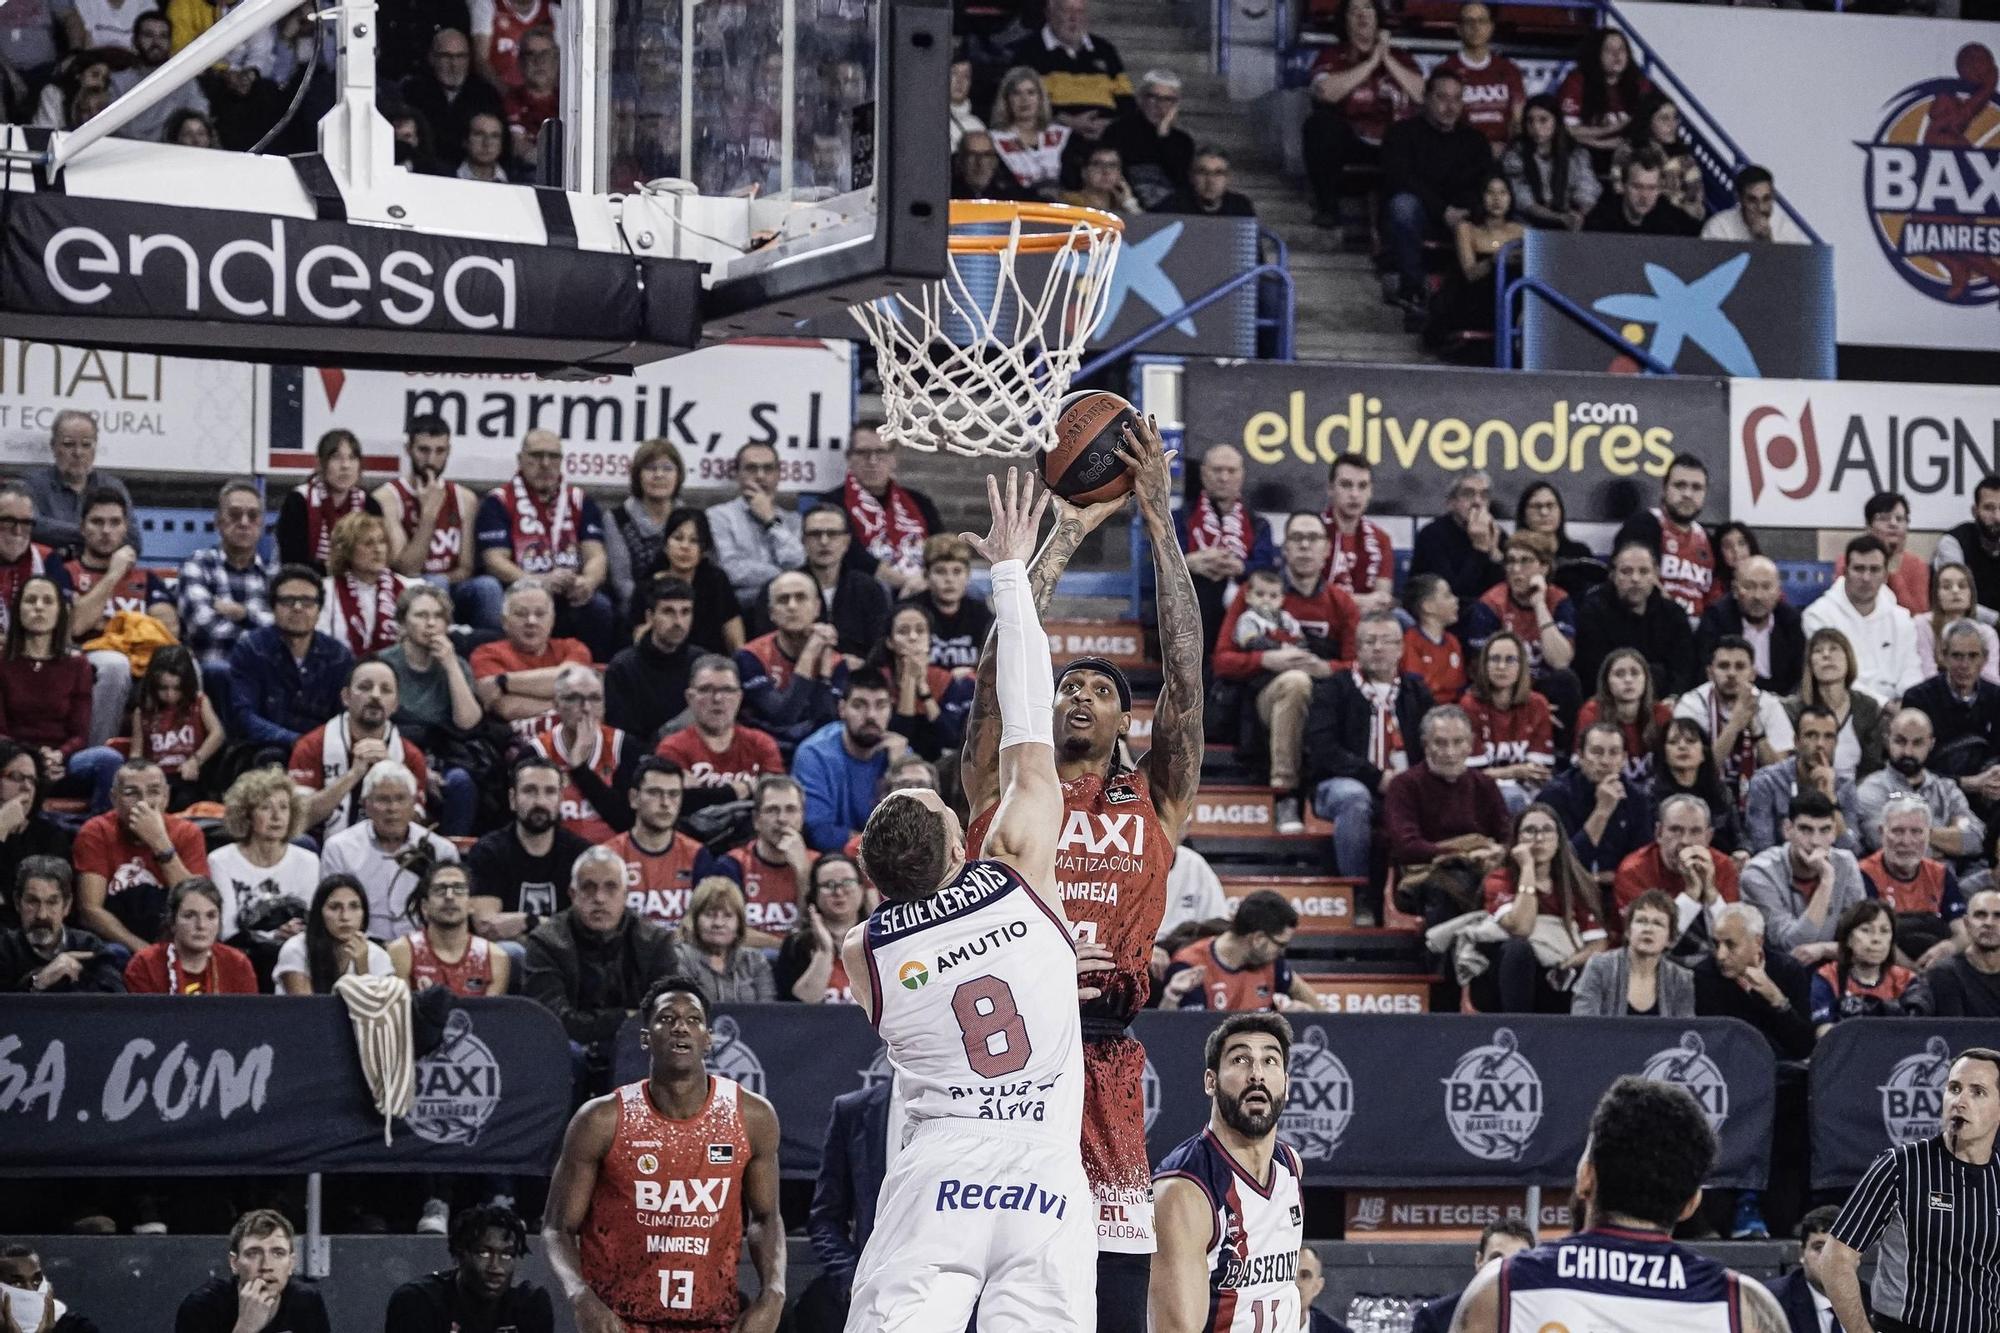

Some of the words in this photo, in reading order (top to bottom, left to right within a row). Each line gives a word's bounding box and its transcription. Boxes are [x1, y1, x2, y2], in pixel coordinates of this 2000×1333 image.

[1873, 147, 2000, 214] BAX
[1904, 223, 2000, 255] MANRES
[43, 217, 517, 330] endesa
[404, 384, 722, 453] marmik,
[749, 391, 841, 451] s.l.
[1569, 402, 1638, 424] .com
[1243, 390, 1676, 478] eldivendres
[1196, 804, 1269, 823] BAGES
[1057, 810, 1144, 856] AXI
[1055, 855, 1144, 874] MATIZACIÓN
[1057, 880, 1119, 907] ANRESA
[1290, 896, 1348, 917] AGES
[936, 920, 1028, 973] AMUTIO
[1345, 993, 1422, 1014] BAGES
[951, 974, 1033, 1079] 8
[1285, 1081, 1349, 1111] AXI
[1451, 1083, 1538, 1112] BAXI
[634, 1177, 732, 1213] BAXI
[936, 1179, 1067, 1221] Recalvi
[1100, 1204, 1129, 1222] ETL
[1392, 1204, 1500, 1225] NETEGES
[1097, 1224, 1150, 1240] GLOBAL
[1557, 1245, 1688, 1290] CHIOZZA
[658, 1269, 695, 1310] 13
